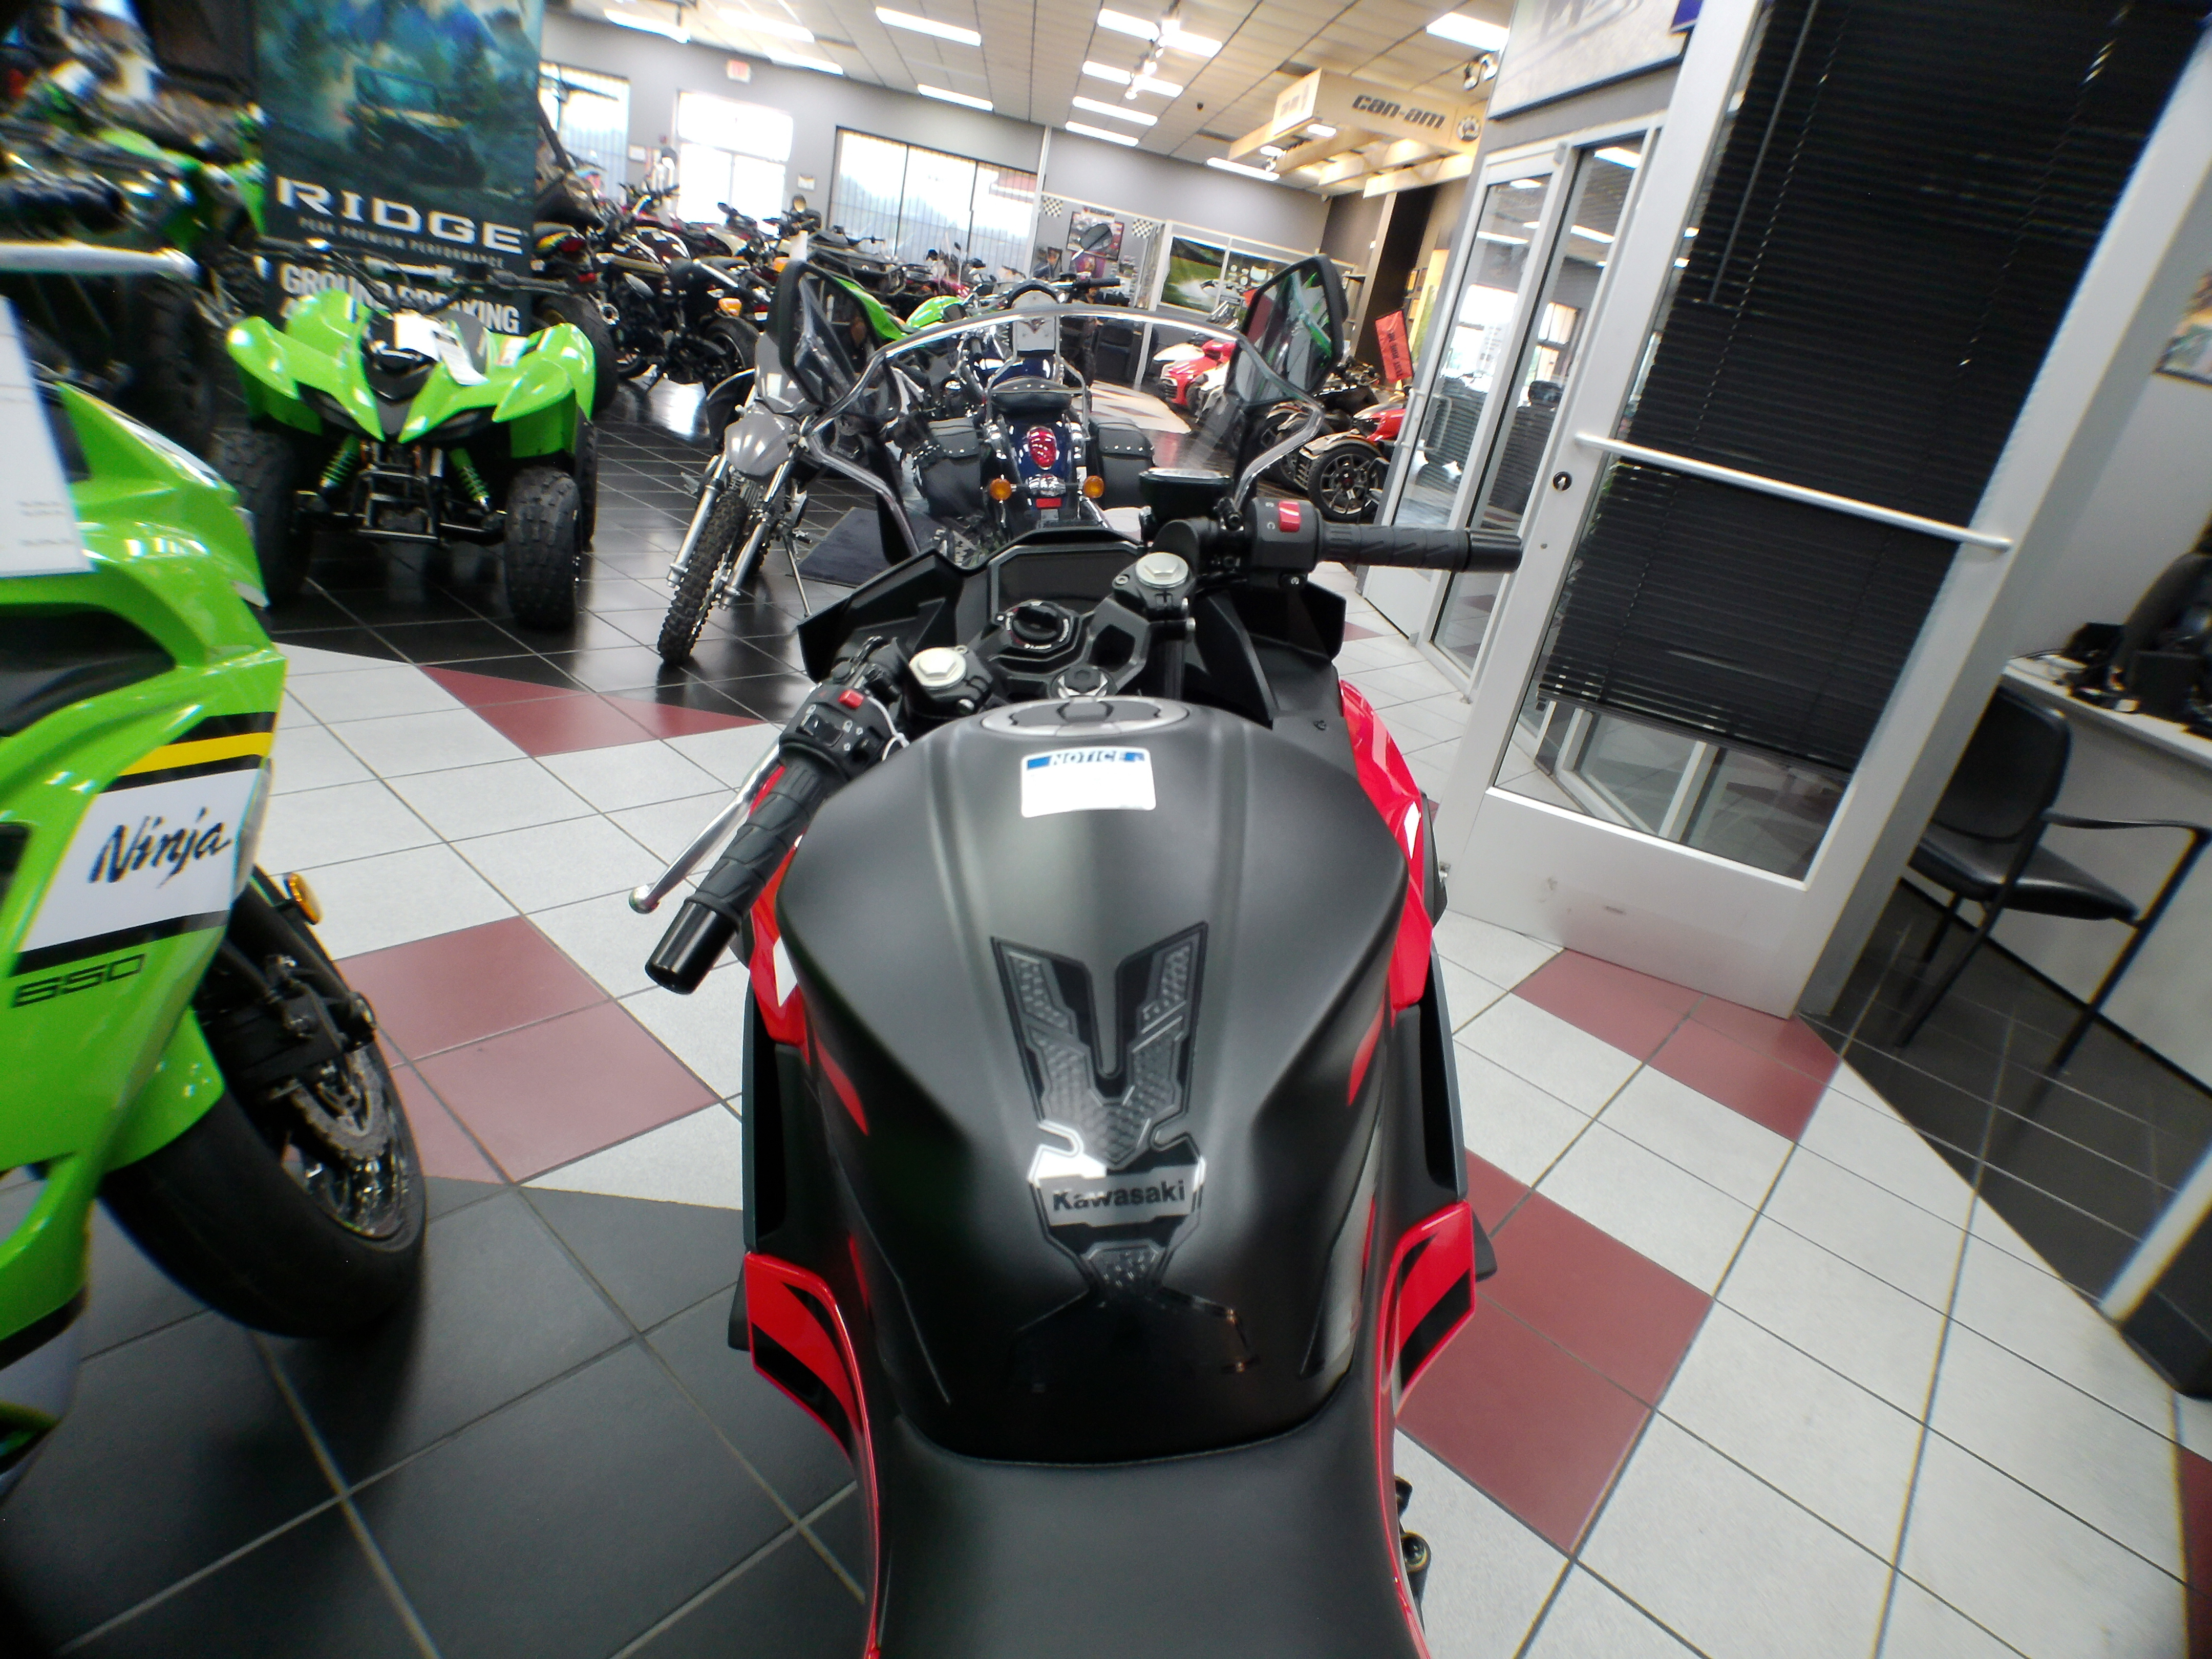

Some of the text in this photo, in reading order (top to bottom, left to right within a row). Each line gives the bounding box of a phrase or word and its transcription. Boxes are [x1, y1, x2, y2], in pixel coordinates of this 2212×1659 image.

[1352, 94, 1445, 129] can-am
[276, 176, 523, 254] RIDGE
[87, 806, 233, 889] Ninja
[14, 953, 145, 1007] 650
[1052, 1179, 1187, 1212] Kawasaki
